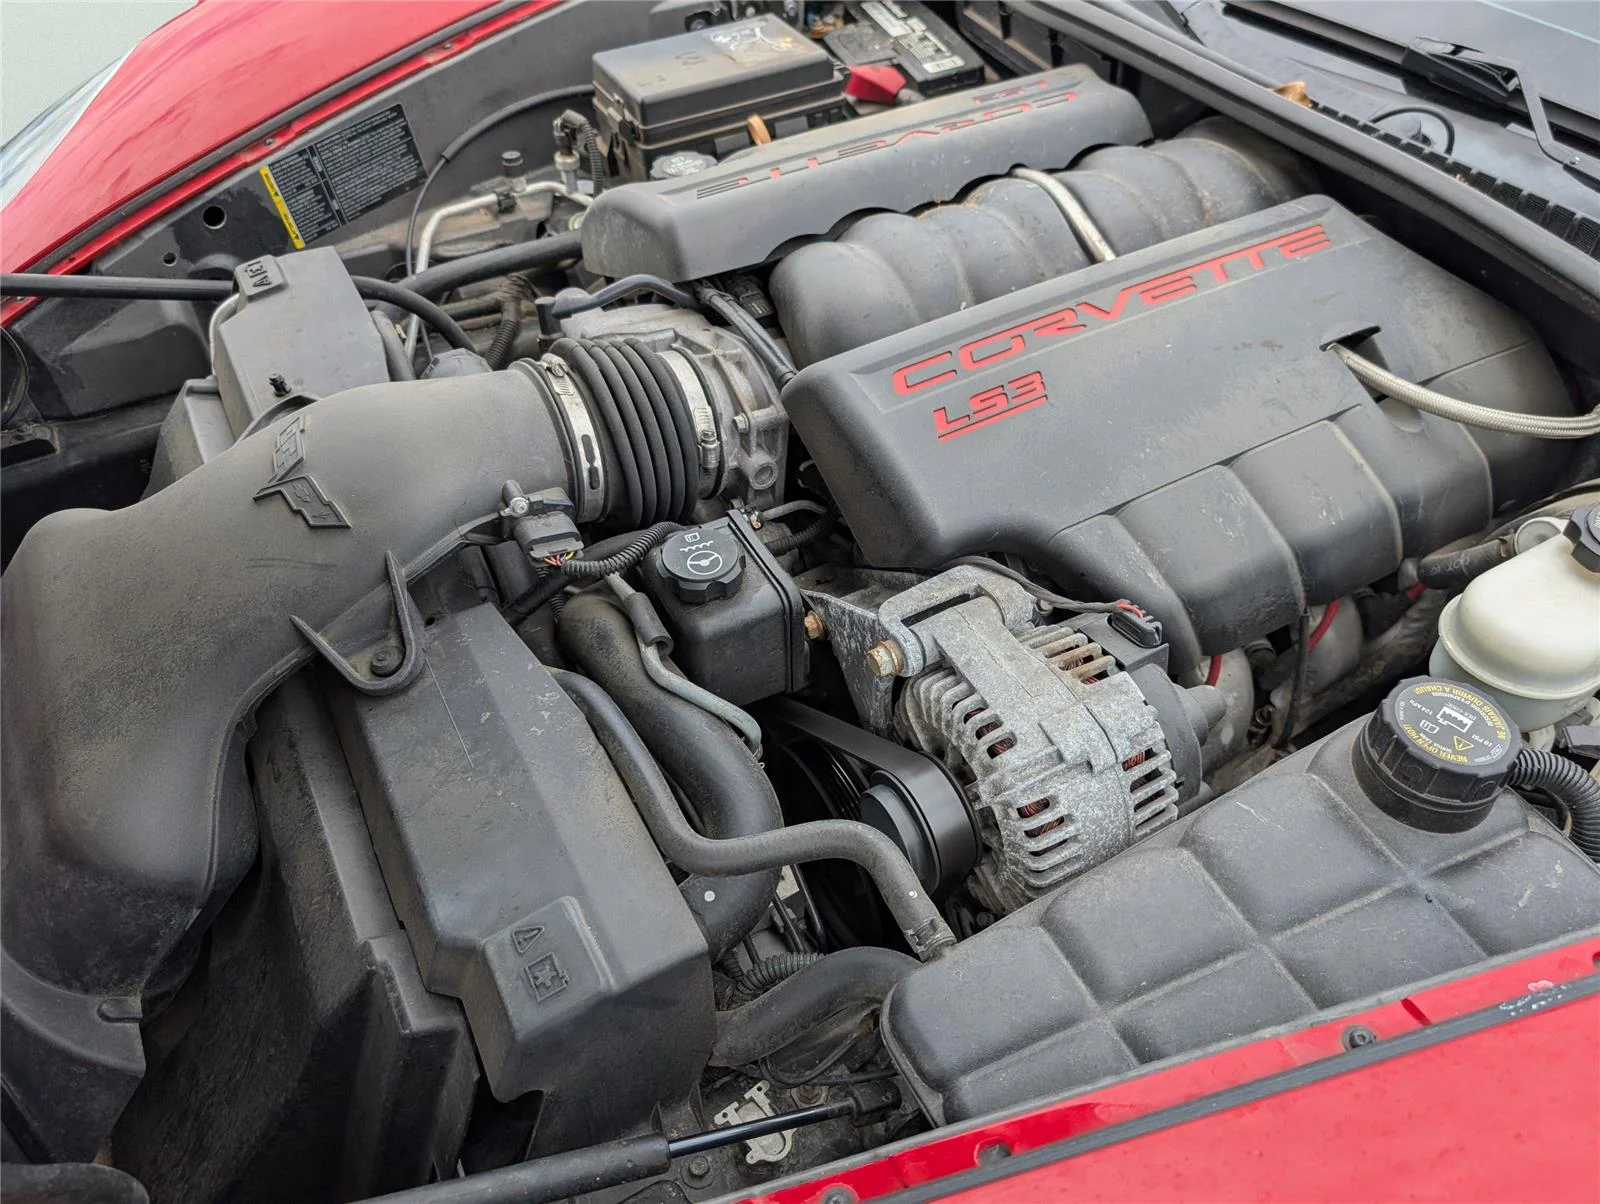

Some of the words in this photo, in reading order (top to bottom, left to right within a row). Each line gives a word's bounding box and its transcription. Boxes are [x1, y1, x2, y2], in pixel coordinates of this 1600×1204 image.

[892, 224, 1331, 396] CORVETTE
[933, 371, 1046, 437] LS3
[1453, 688, 1484, 706] OUVRIR
[1482, 705, 1505, 730] JAMAIS
[1415, 735, 1439, 754] OPEN
[1440, 747, 1468, 764] NEVER
